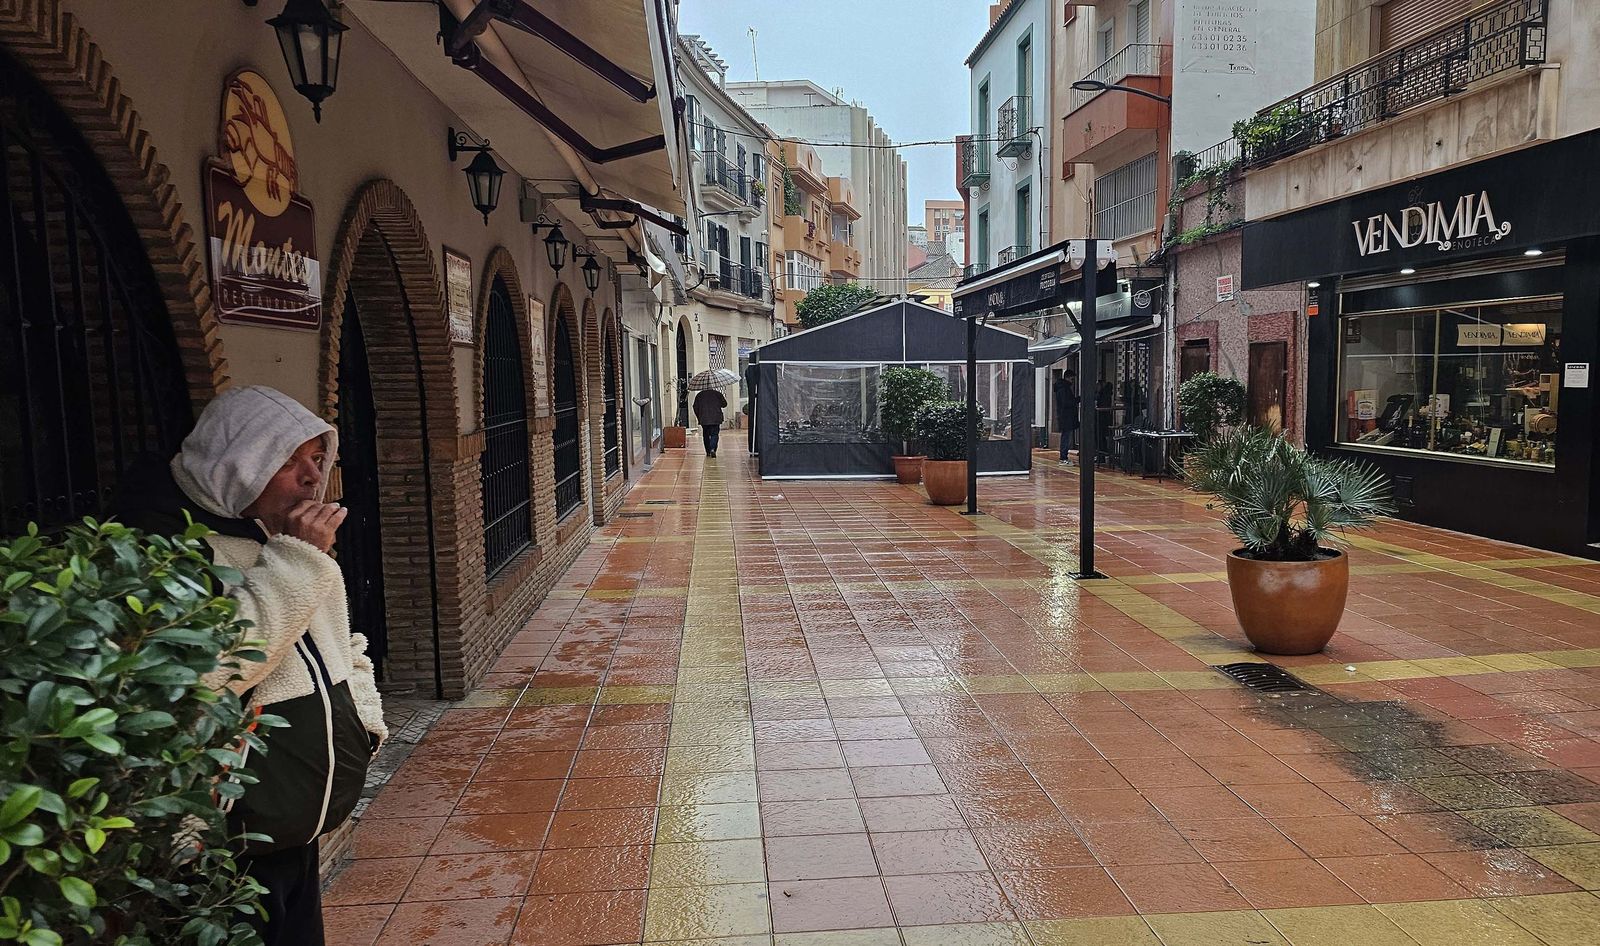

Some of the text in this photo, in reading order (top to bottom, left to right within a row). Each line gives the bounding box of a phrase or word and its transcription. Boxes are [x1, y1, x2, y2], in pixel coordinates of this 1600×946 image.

[1223, 34, 1234, 42] 02
[1236, 34, 1248, 42] 35
[1223, 43, 1234, 51] 02
[1352, 190, 1511, 257] VENDIMIA
[1452, 235, 1496, 250] ENOTECA
